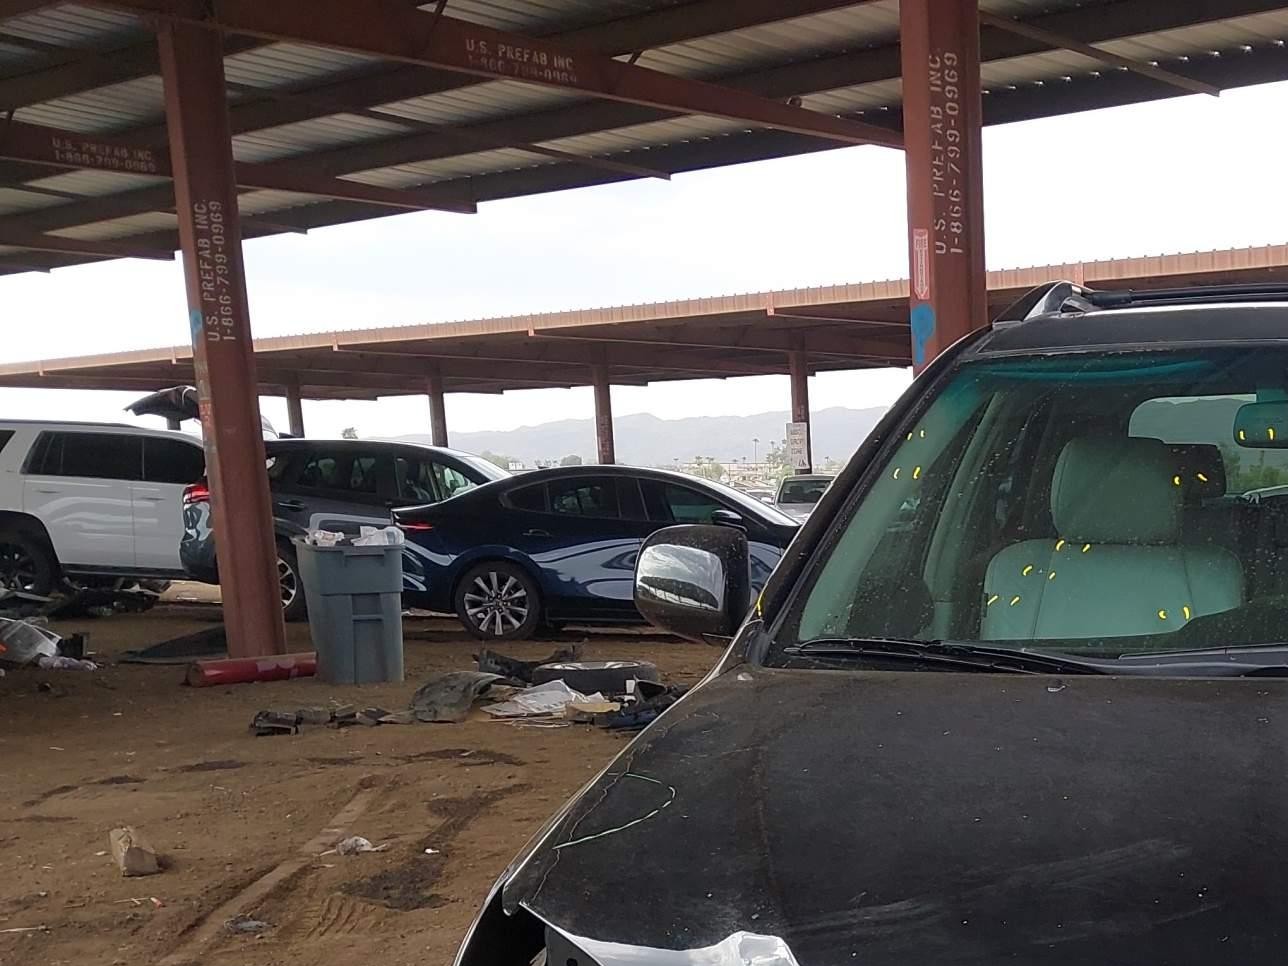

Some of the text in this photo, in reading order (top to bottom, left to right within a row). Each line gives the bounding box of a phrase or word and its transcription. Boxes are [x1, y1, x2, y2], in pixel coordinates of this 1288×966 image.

[498, 43, 548, 66] PREFAB
[930, 105, 945, 198] PREFAB
[943, 51, 964, 255] 1-866-799-0969
[934, 212, 947, 254] U.S.
[198, 238, 216, 301] PREFAB
[209, 200, 236, 341] 1-866-799-0969
[206, 311, 220, 342] U.S.
